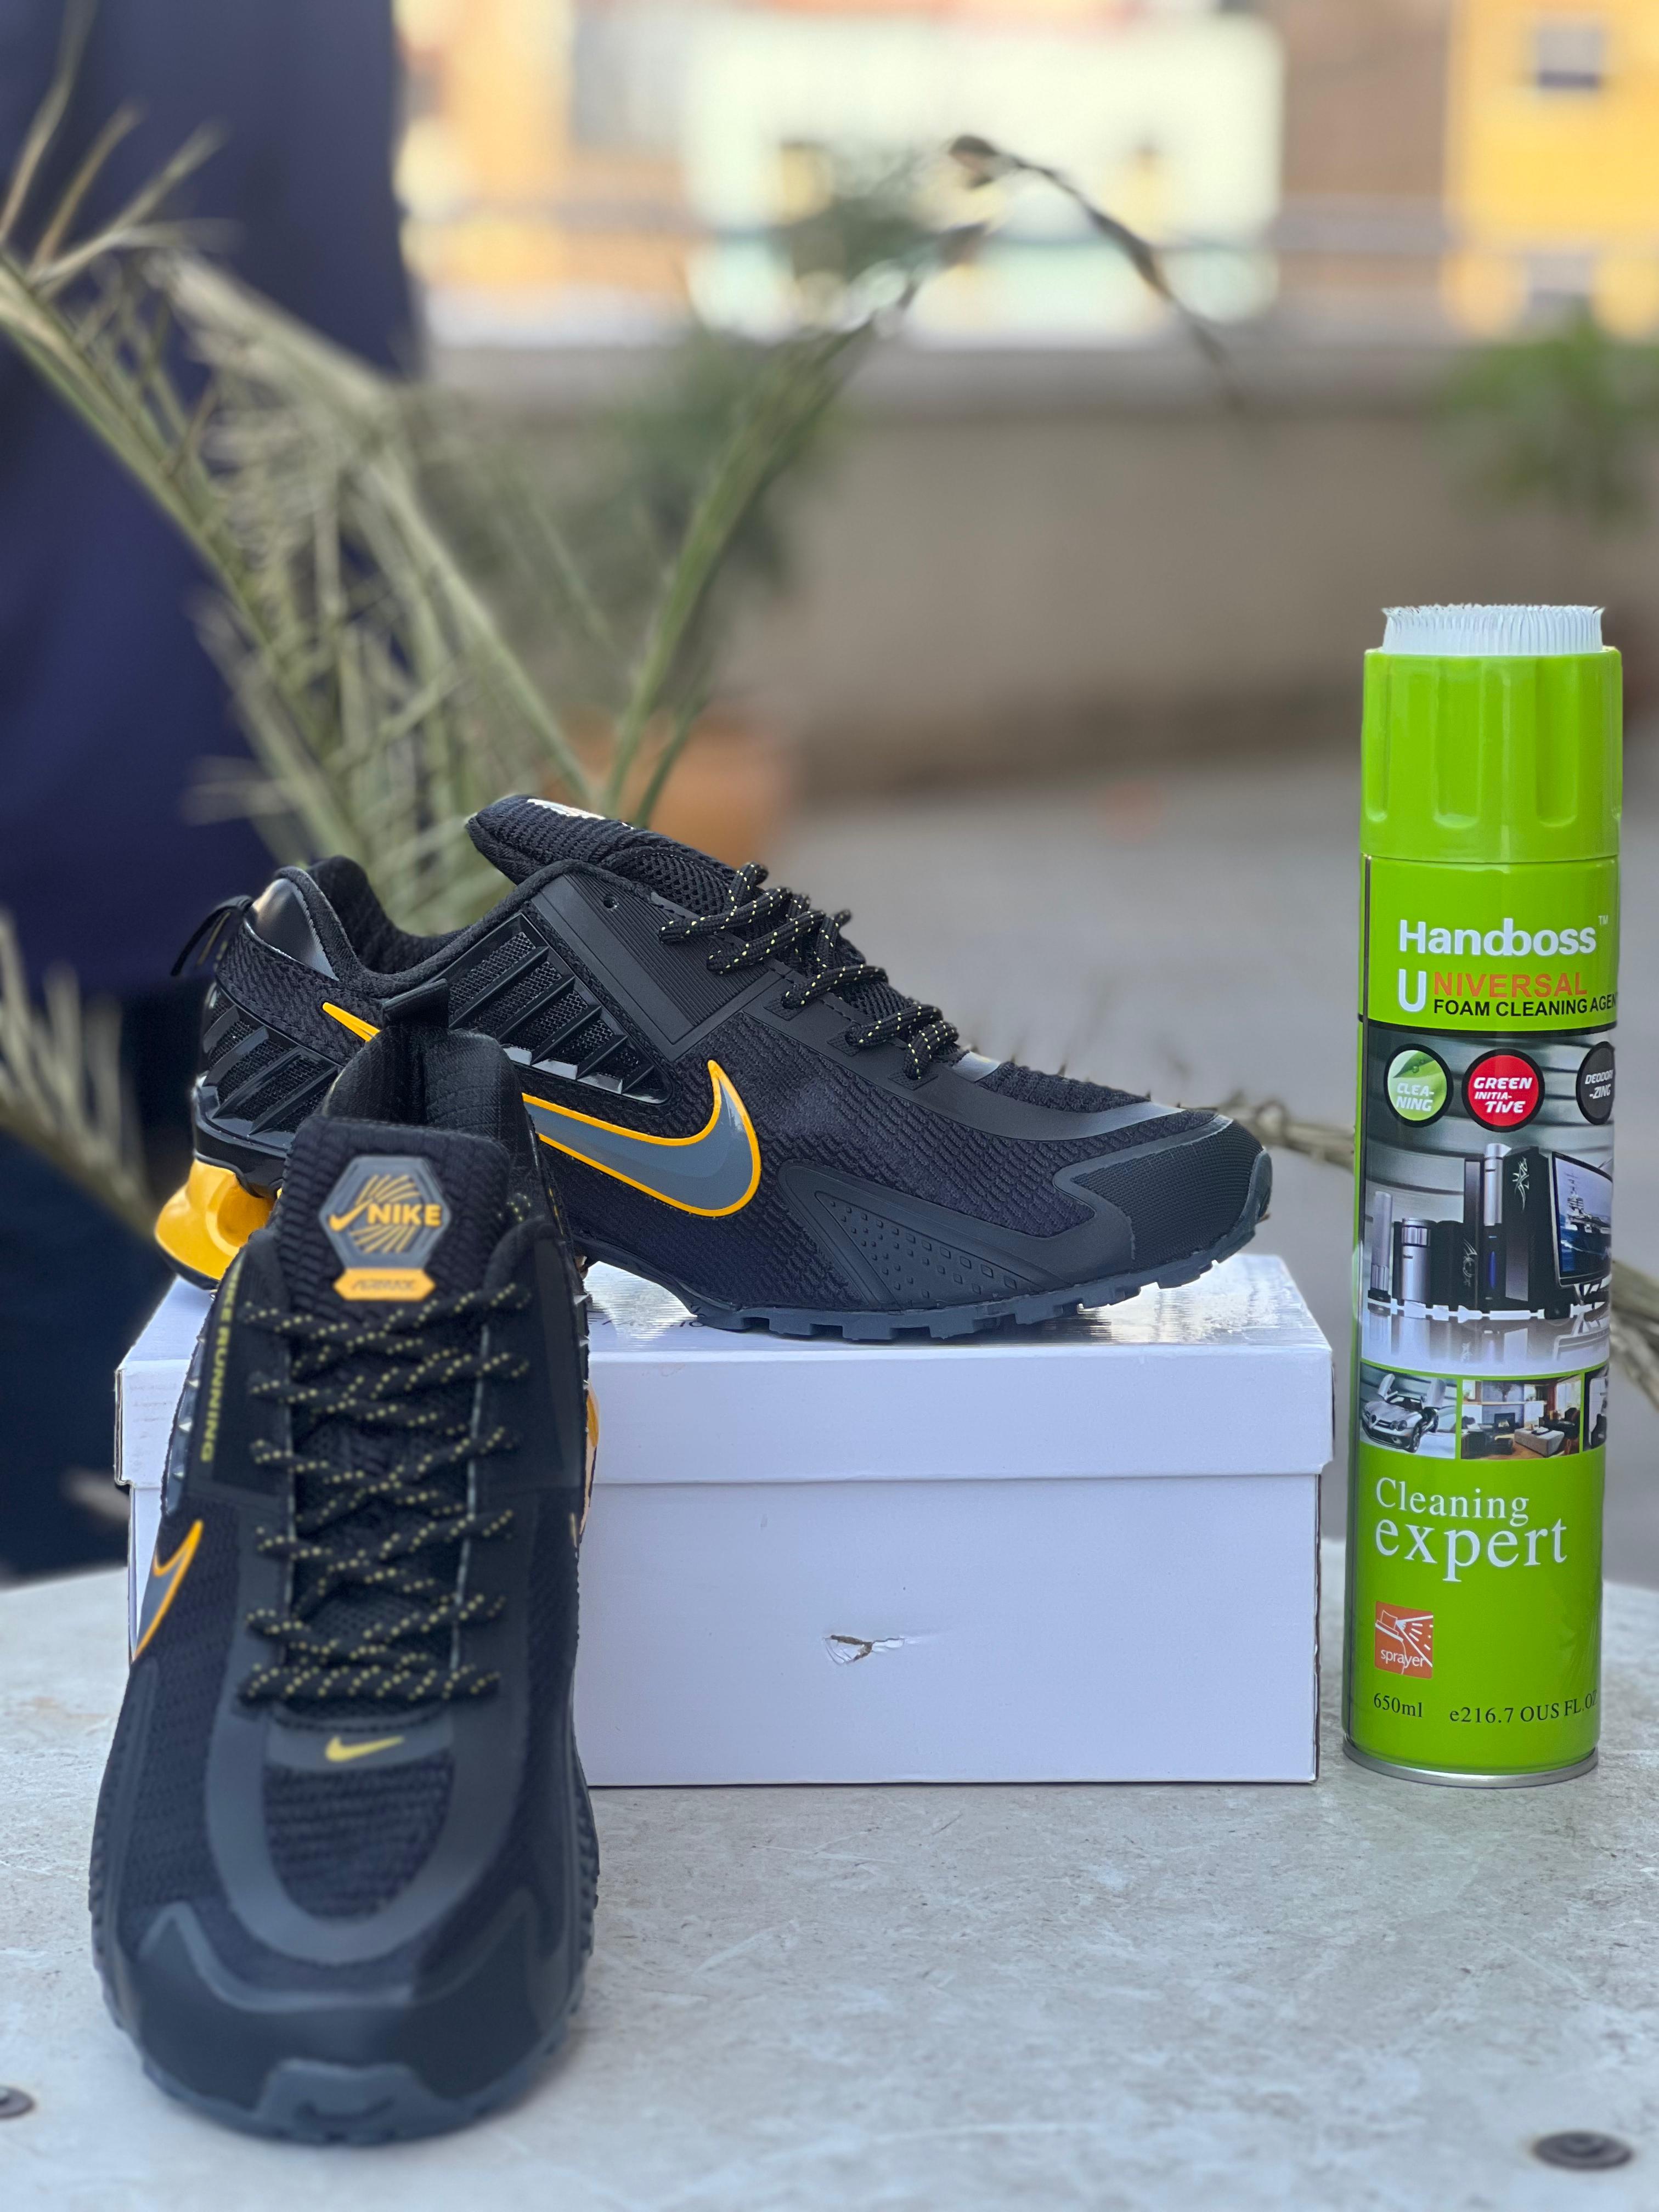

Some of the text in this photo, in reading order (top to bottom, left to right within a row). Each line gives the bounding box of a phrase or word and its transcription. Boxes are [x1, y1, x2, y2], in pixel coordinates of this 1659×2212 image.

[1399, 917, 1596, 956] Handboss
[1434, 992, 1618, 1017] FOAM CLEANING AGEN
[1474, 1076, 1532, 1090] GREEN
[1396, 1096, 1433, 1112] NING
[1485, 1100, 1526, 1114] TIVE
[366, 1203, 442, 1227] NIKE
[200, 1326, 230, 1463] RUNNING
[1376, 1477, 1530, 1527] Cleaning
[1375, 1518, 1567, 1583] expert
[1380, 1649, 1425, 1668] sprayer
[1374, 1692, 1424, 1718] 650ml
[1520, 1702, 1559, 1723] OUS
